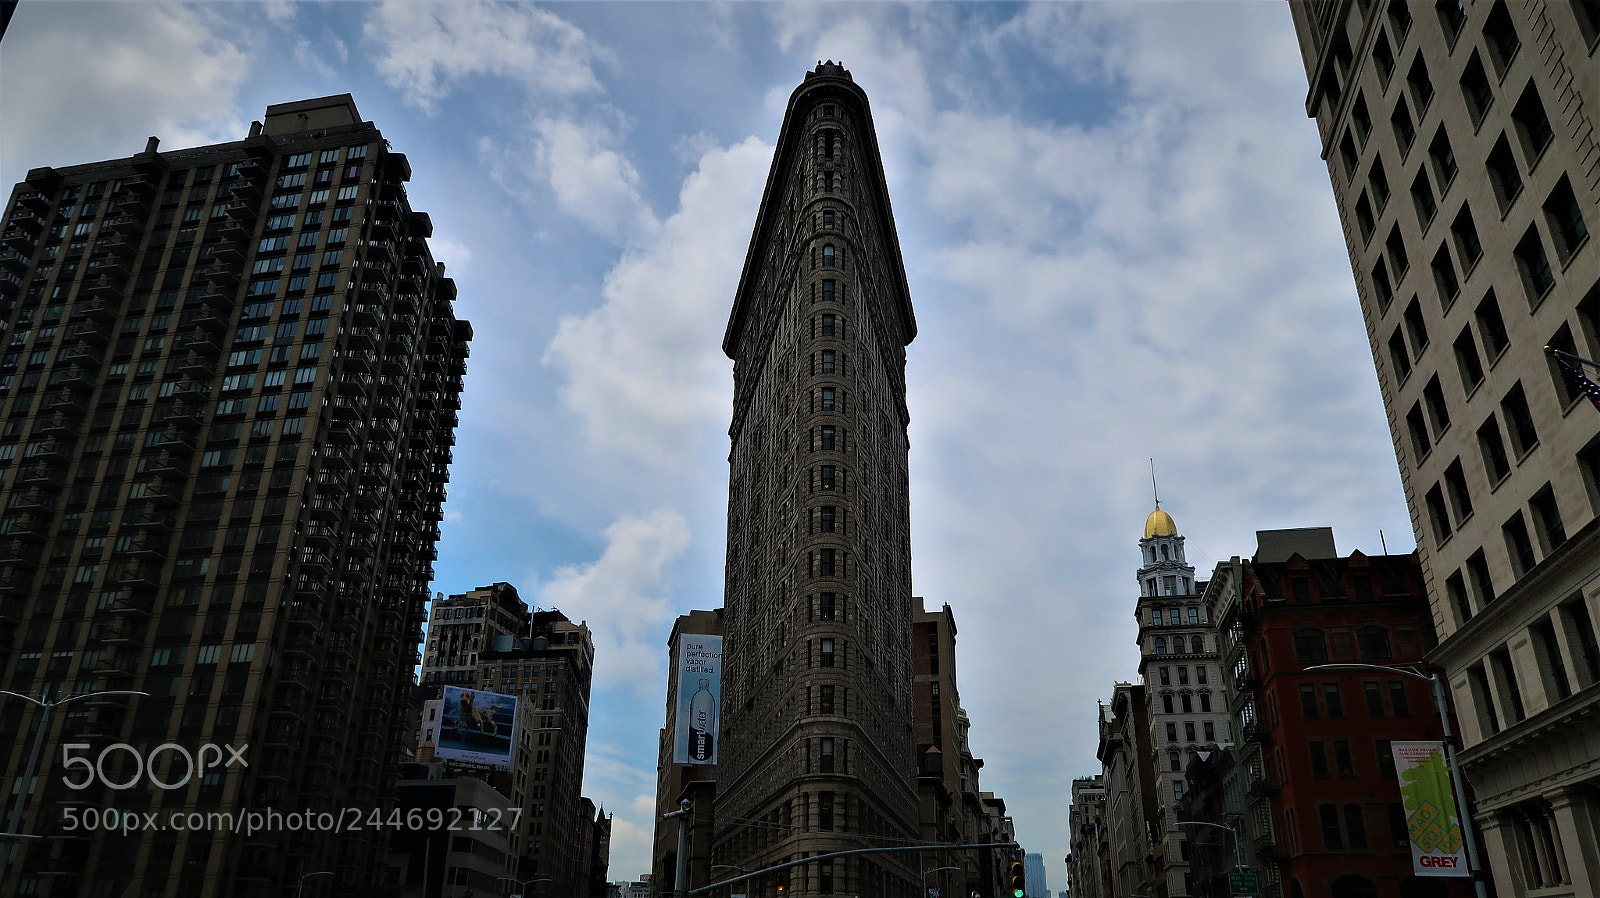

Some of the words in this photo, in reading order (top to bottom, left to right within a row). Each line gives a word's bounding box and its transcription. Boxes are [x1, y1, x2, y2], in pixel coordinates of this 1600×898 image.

[687, 651, 722, 659] perfection
[1408, 809, 1435, 835] MAD.
[1421, 831, 1442, 849] SQ.
[1419, 855, 1459, 868] GREY
